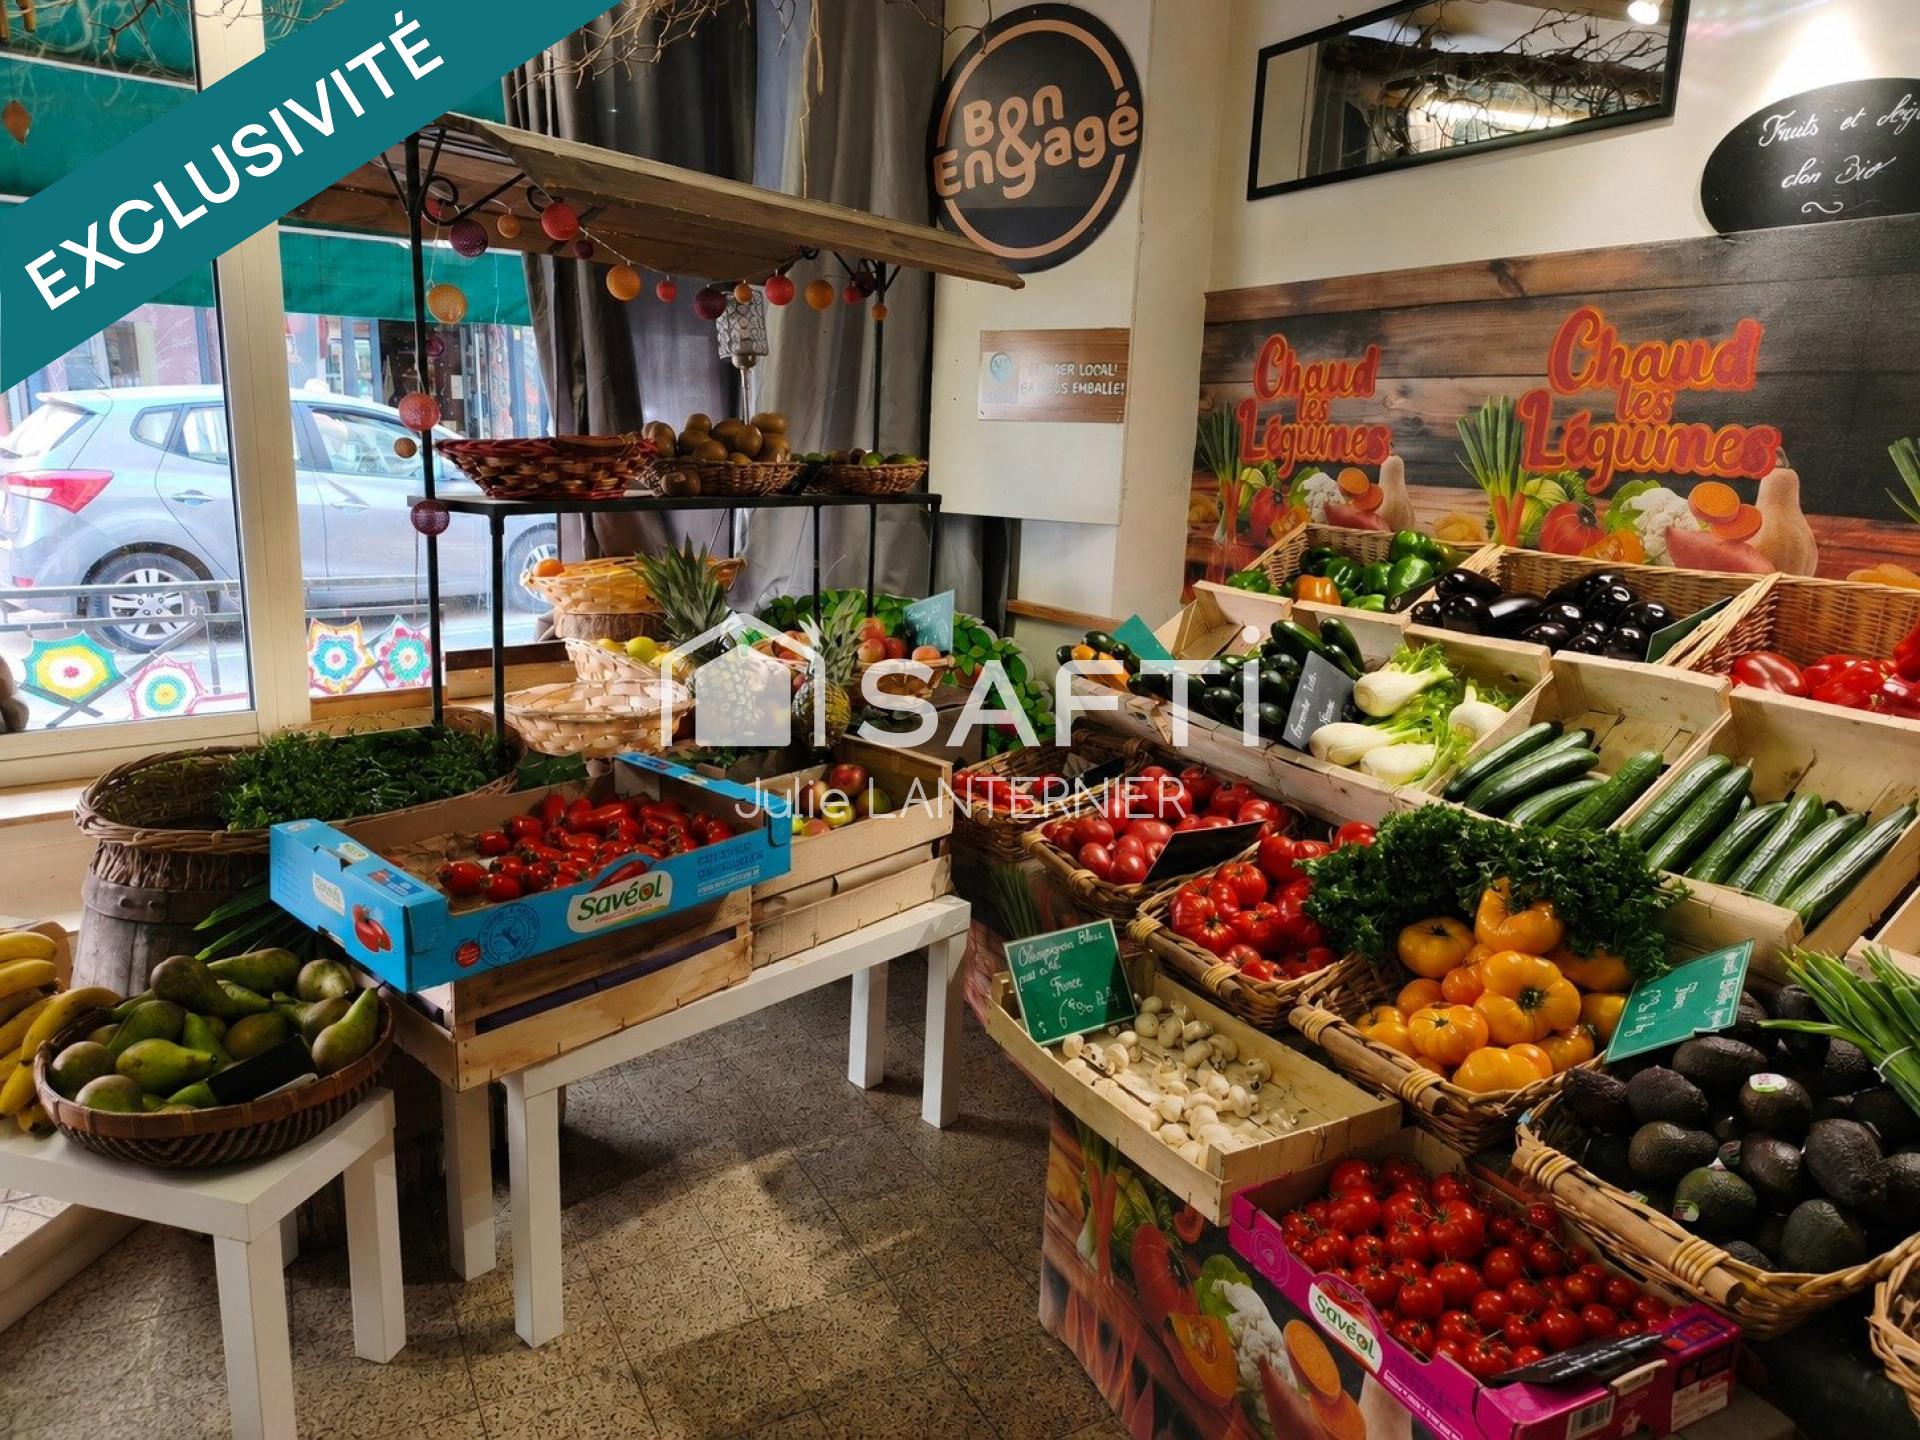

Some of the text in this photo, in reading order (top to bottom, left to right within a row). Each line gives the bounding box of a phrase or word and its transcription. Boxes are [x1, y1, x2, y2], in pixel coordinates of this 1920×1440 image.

[1839, 107, 1867, 131] et
[1079, 363, 1118, 376] LOCAL!
[1254, 333, 1383, 402] Chaud
[1549, 307, 1764, 394] Chaud
[1072, 382, 1125, 396] EMBALLE!
[1296, 387, 1330, 424] les
[1615, 378, 1677, 425] les
[1237, 397, 1394, 479] Légumes
[1516, 388, 1783, 494] Légumes
[577, 874, 664, 921] Savéol
[1314, 1294, 1375, 1360] Savéol
